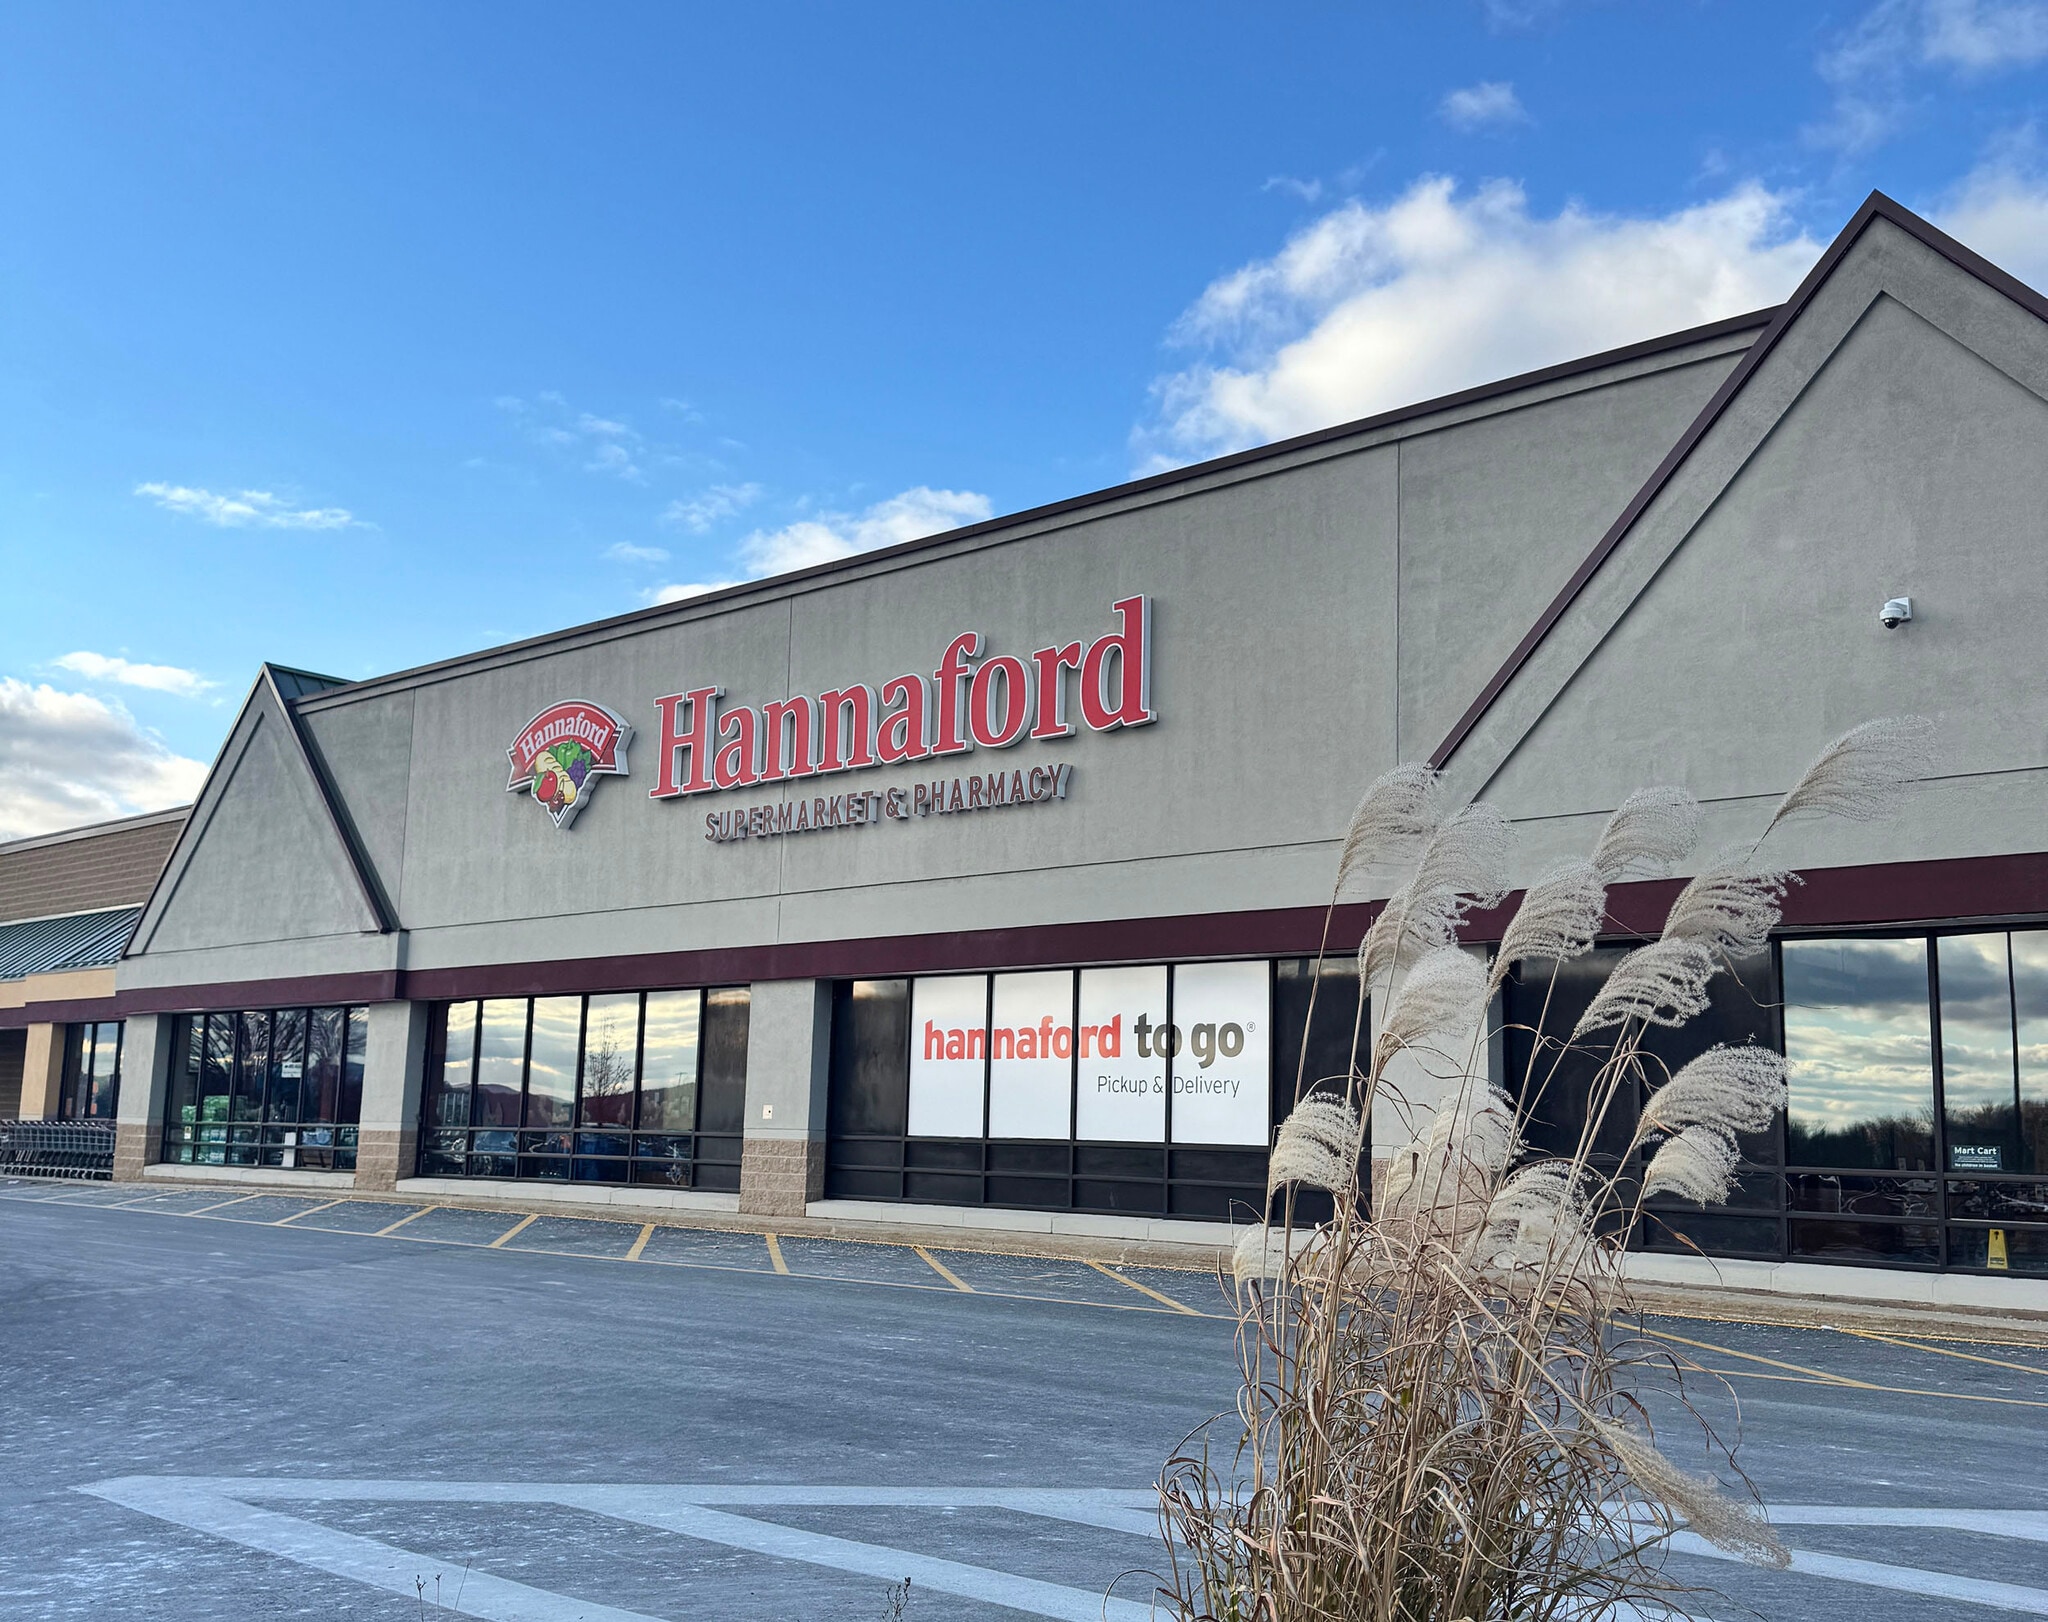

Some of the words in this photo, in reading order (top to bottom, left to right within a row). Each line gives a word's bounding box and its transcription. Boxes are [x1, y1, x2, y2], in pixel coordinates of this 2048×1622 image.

[649, 594, 1155, 799] Hannaford
[520, 711, 610, 763] Hannaford
[704, 790, 880, 842] SUPERMARKET
[884, 787, 906, 819] &
[913, 763, 1073, 816] PHARMACY
[924, 1013, 1121, 1060] hannaford
[1134, 1012, 1183, 1059] to
[1097, 1075, 1148, 1097] Pickup
[1152, 1075, 1164, 1094] &
[1173, 1075, 1241, 1098] Delivery
[1954, 1146, 1975, 1155] Mart
[1977, 1147, 1997, 1155] Cart
